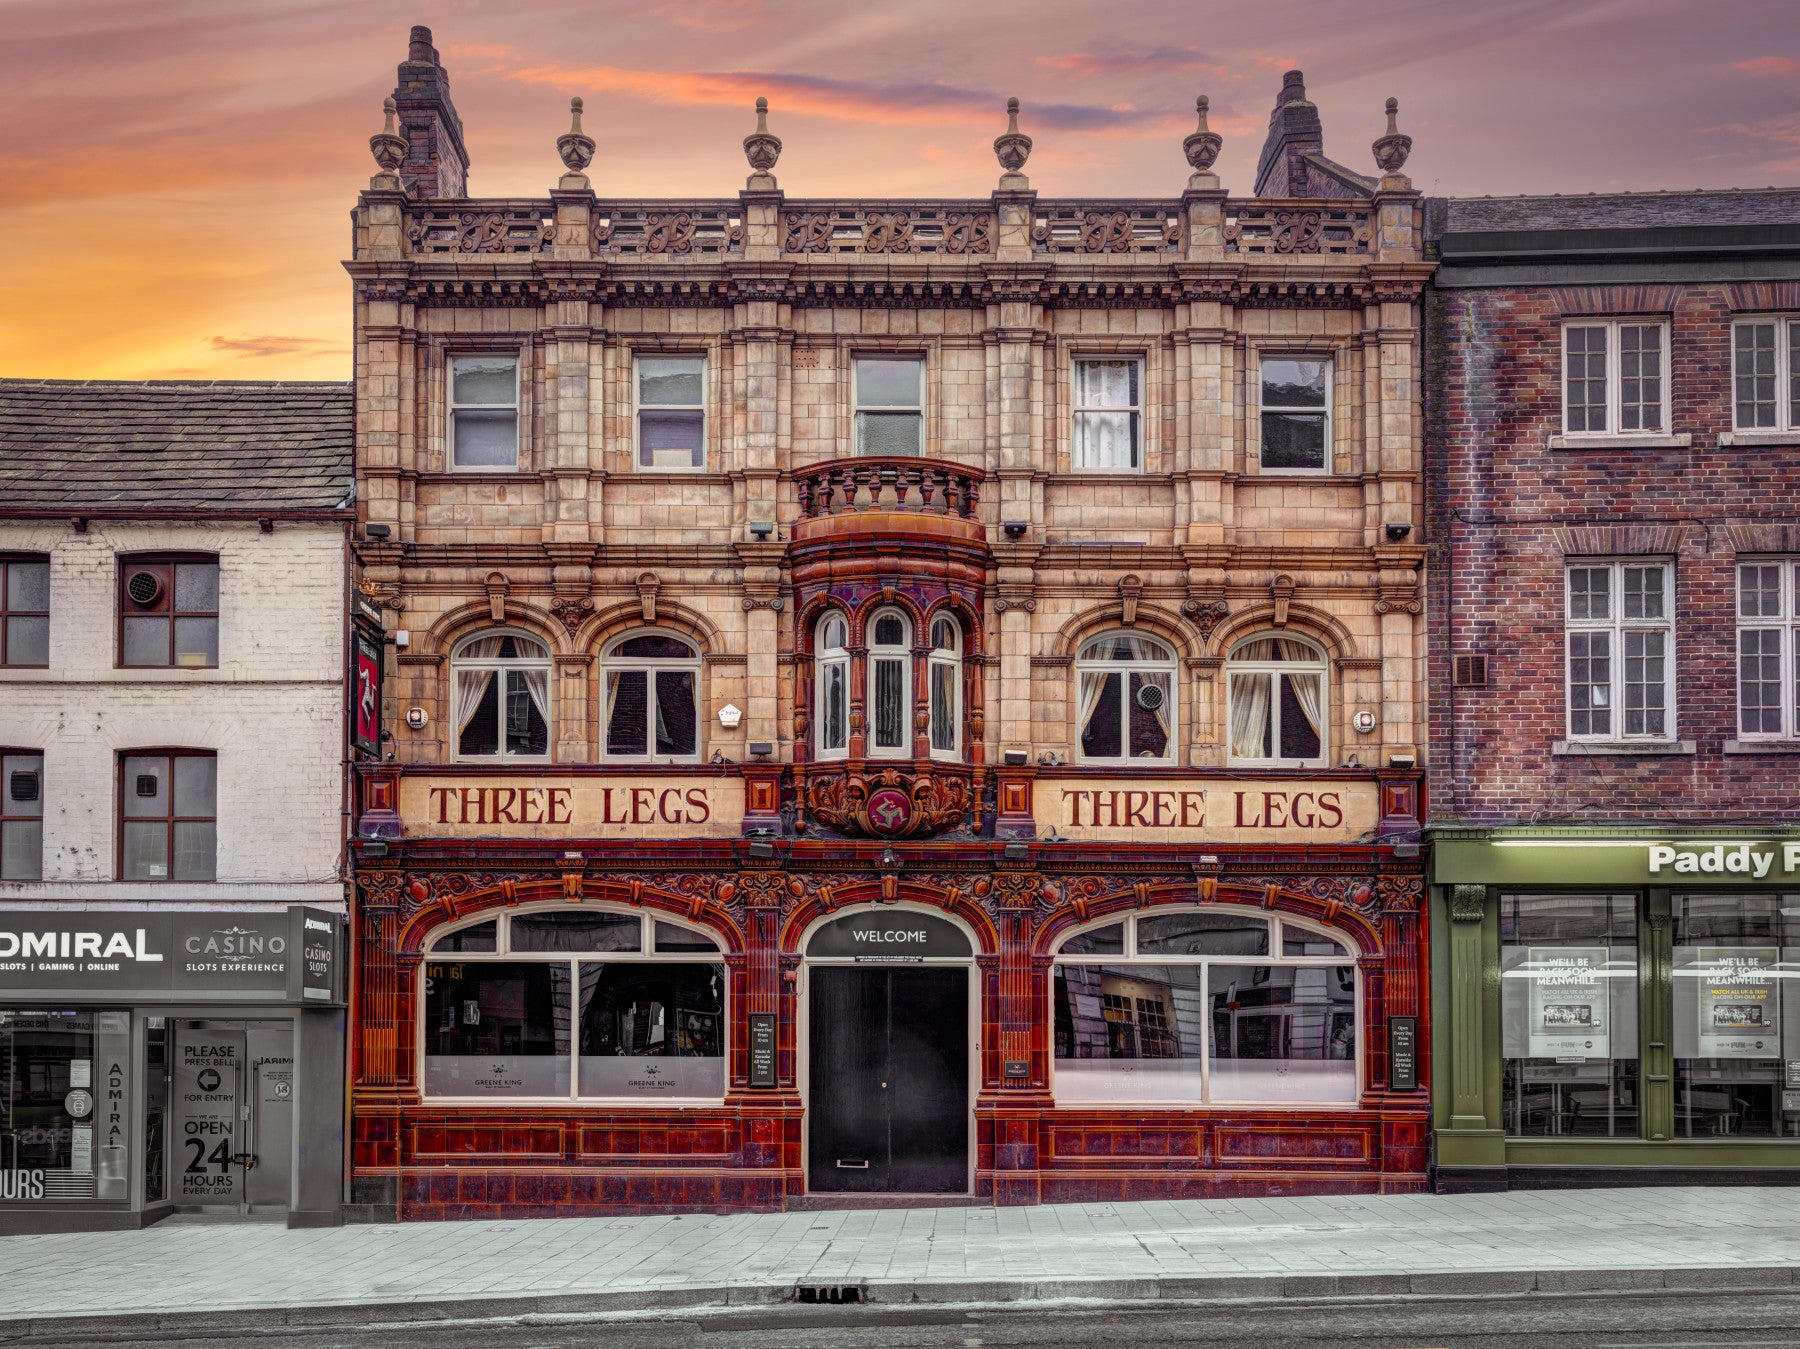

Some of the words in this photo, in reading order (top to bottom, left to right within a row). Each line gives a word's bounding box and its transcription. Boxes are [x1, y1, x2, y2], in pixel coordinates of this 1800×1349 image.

[429, 788, 572, 824] THREE
[602, 788, 711, 825] LEGS
[1062, 791, 1205, 828] THREE
[1234, 791, 1343, 828] LEGS
[1649, 846, 1774, 878] Paddy
[853, 931, 927, 942] WELCOME
[185, 936, 286, 954] CASINO
[305, 947, 331, 962] CASINO
[39, 963, 75, 971] GAMING
[87, 963, 120, 971] ONLINE
[309, 962, 327, 972] SLOTS
[1577, 958, 1588, 966] BE
[1748, 958, 1759, 966] BE
[184, 1046, 235, 1057] PLEASE
[184, 1094, 203, 1102] FOR
[205, 1094, 234, 1102] ENTRY
[184, 1121, 232, 1135] OPEN
[185, 1137, 229, 1174] 24
[0, 1169, 44, 1199] URS
[183, 1176, 233, 1187] HOURS
